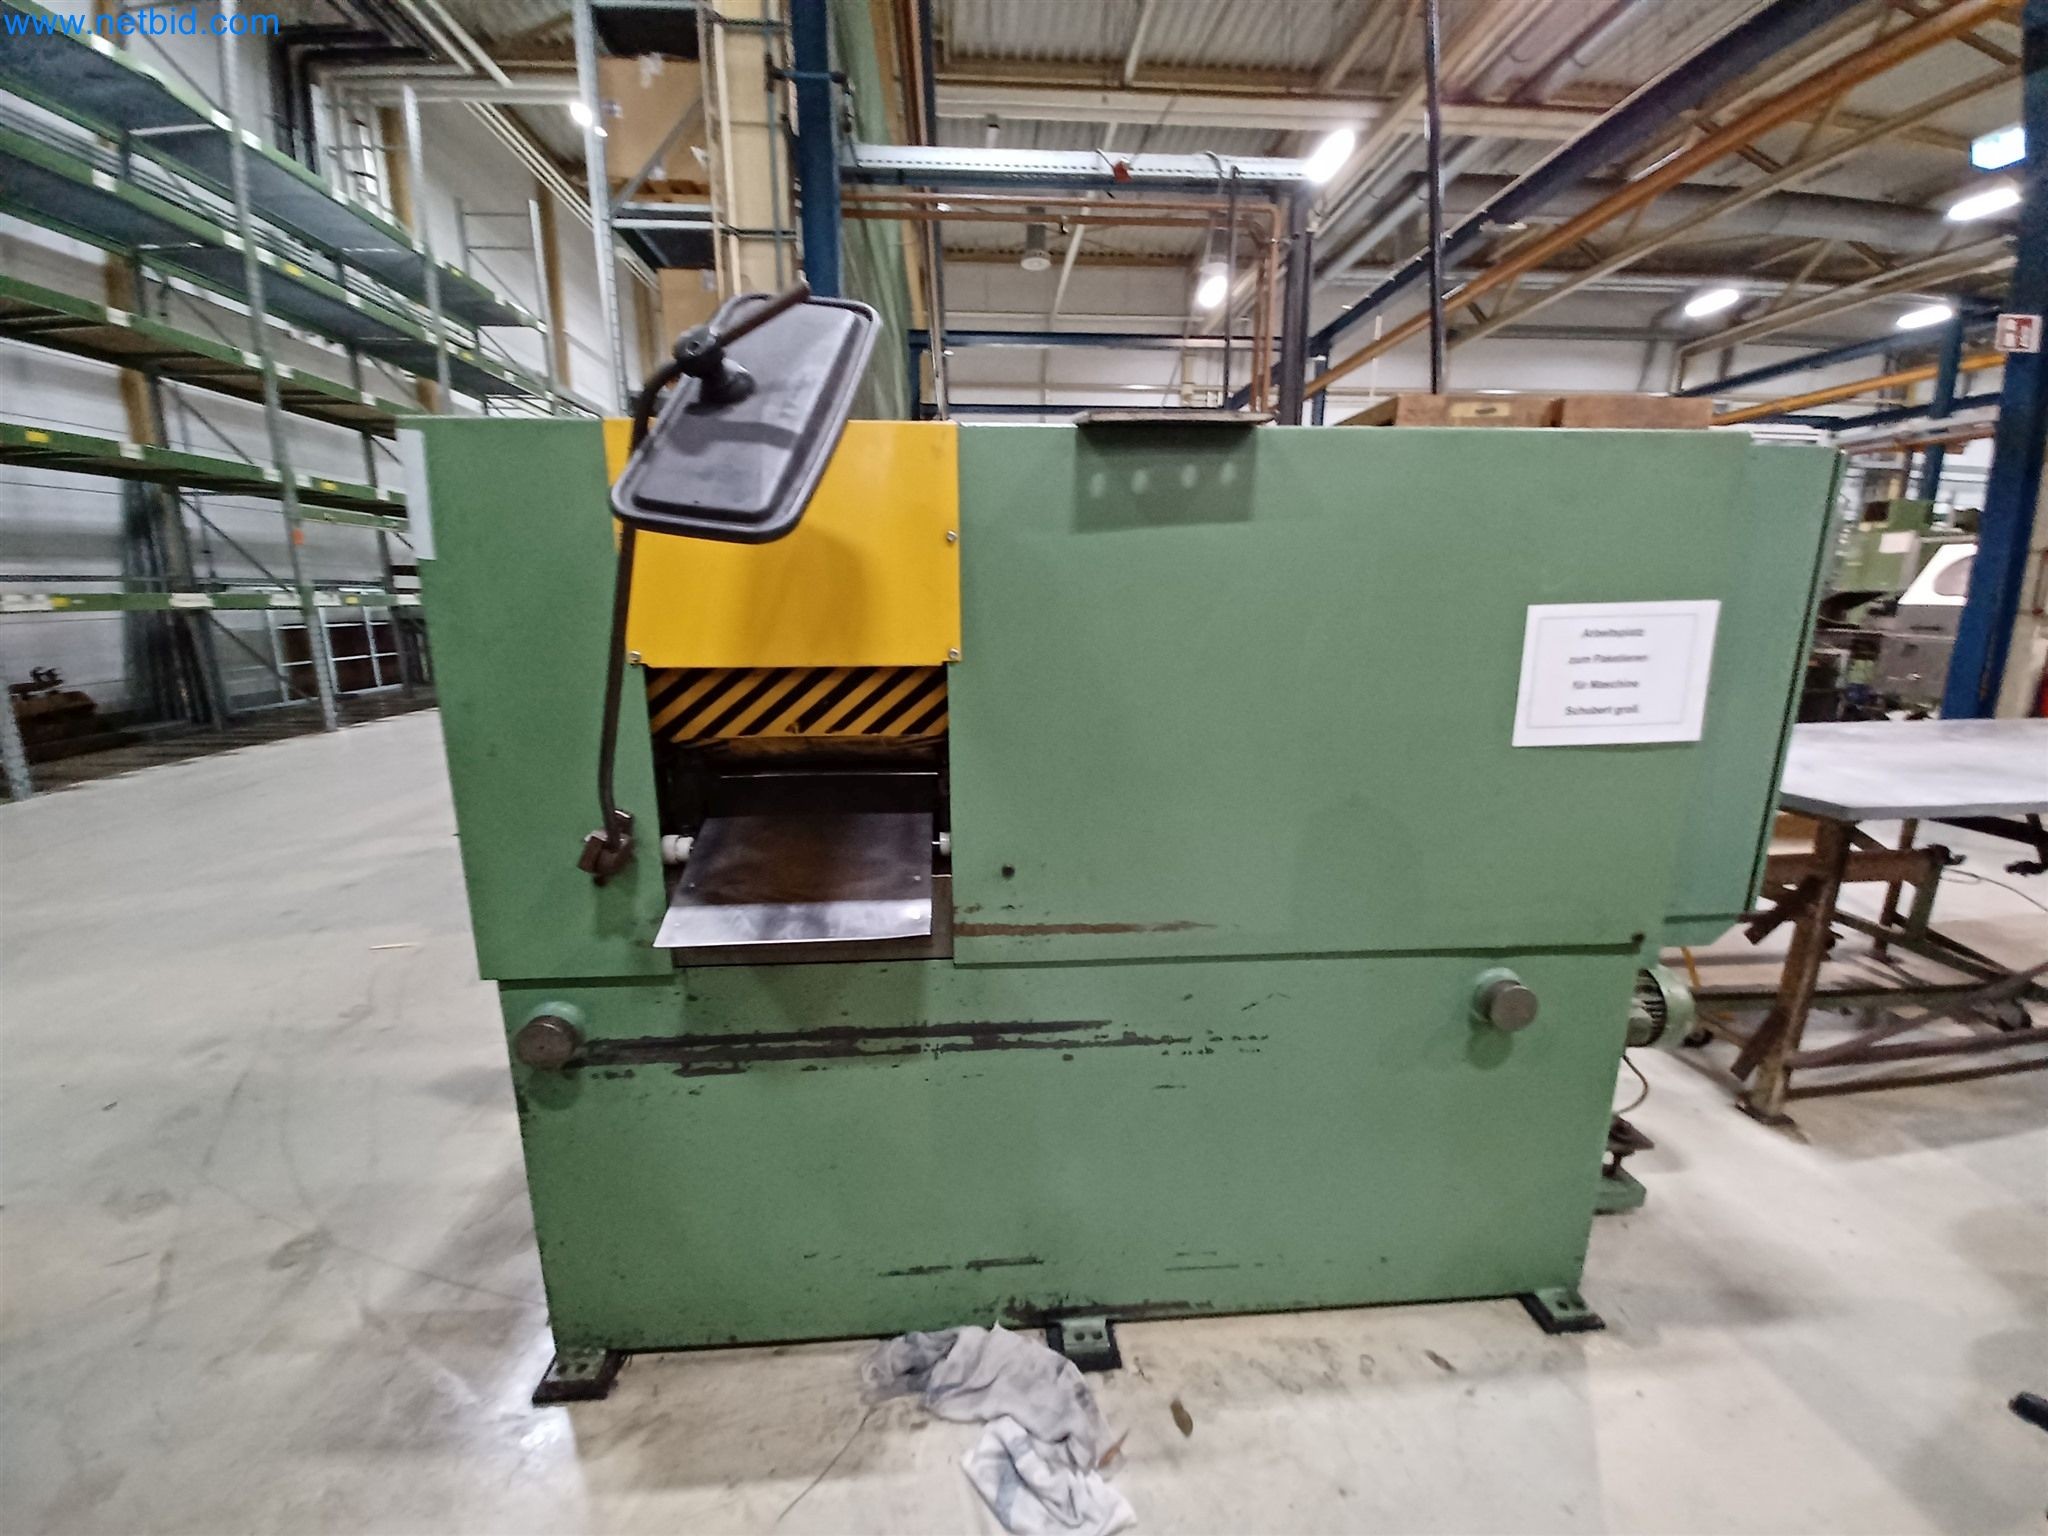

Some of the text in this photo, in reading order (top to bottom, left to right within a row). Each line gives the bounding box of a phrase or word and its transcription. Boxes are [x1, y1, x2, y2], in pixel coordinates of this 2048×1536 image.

[1568, 656, 1591, 665] zum
[1572, 679, 1639, 690] für Maschine
